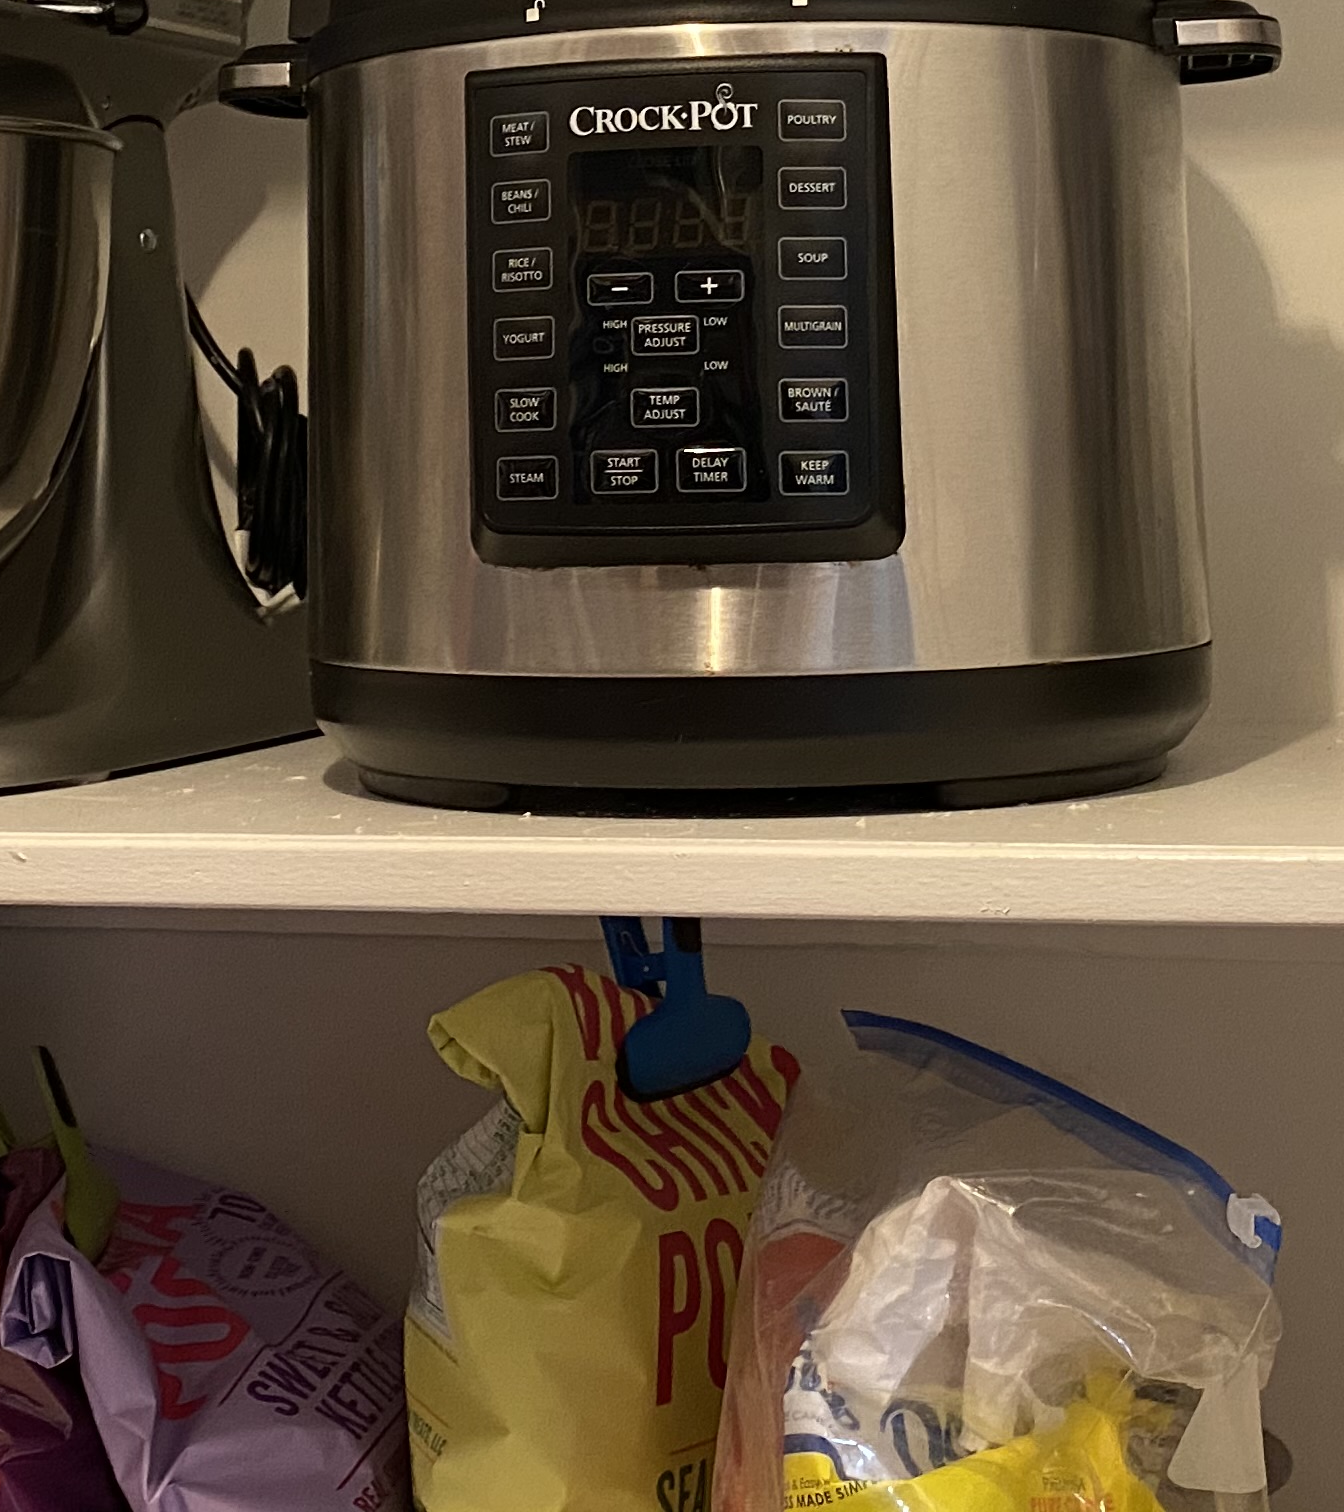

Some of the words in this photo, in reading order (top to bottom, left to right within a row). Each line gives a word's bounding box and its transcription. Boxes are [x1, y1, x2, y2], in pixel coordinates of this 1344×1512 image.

[786, 113, 837, 126] POULTRY
[504, 134, 532, 147] STEW
[788, 181, 836, 194] DESSERT
[507, 202, 533, 215] CHILI
[797, 251, 829, 265] SOUP
[501, 270, 543, 283] RISOTTO
[602, 319, 628, 330] HIGH
[638, 322, 692, 335] PRESSURE
[703, 316, 728, 328] LOW
[784, 320, 842, 333] MULTIGRAIN
[502, 332, 545, 345] YOGURT
[644, 335, 686, 349] ADJUST
[603, 362, 628, 374] HIGH
[704, 360, 729, 371] LOW
[509, 397, 540, 410] SLOW
[649, 394, 680, 407] TEMP
[509, 410, 540, 423] COOK
[644, 408, 685, 421] ADJUST
[607, 456, 641, 469] START
[692, 456, 729, 469] DELAY
[800, 460, 829, 472] KEEP
[509, 471, 544, 484] STEAM
[610, 474, 638, 487] STOP
[693, 471, 729, 484] TIMER
[795, 473, 835, 487] WARM
[796, 1490, 834, 1508] MADE
